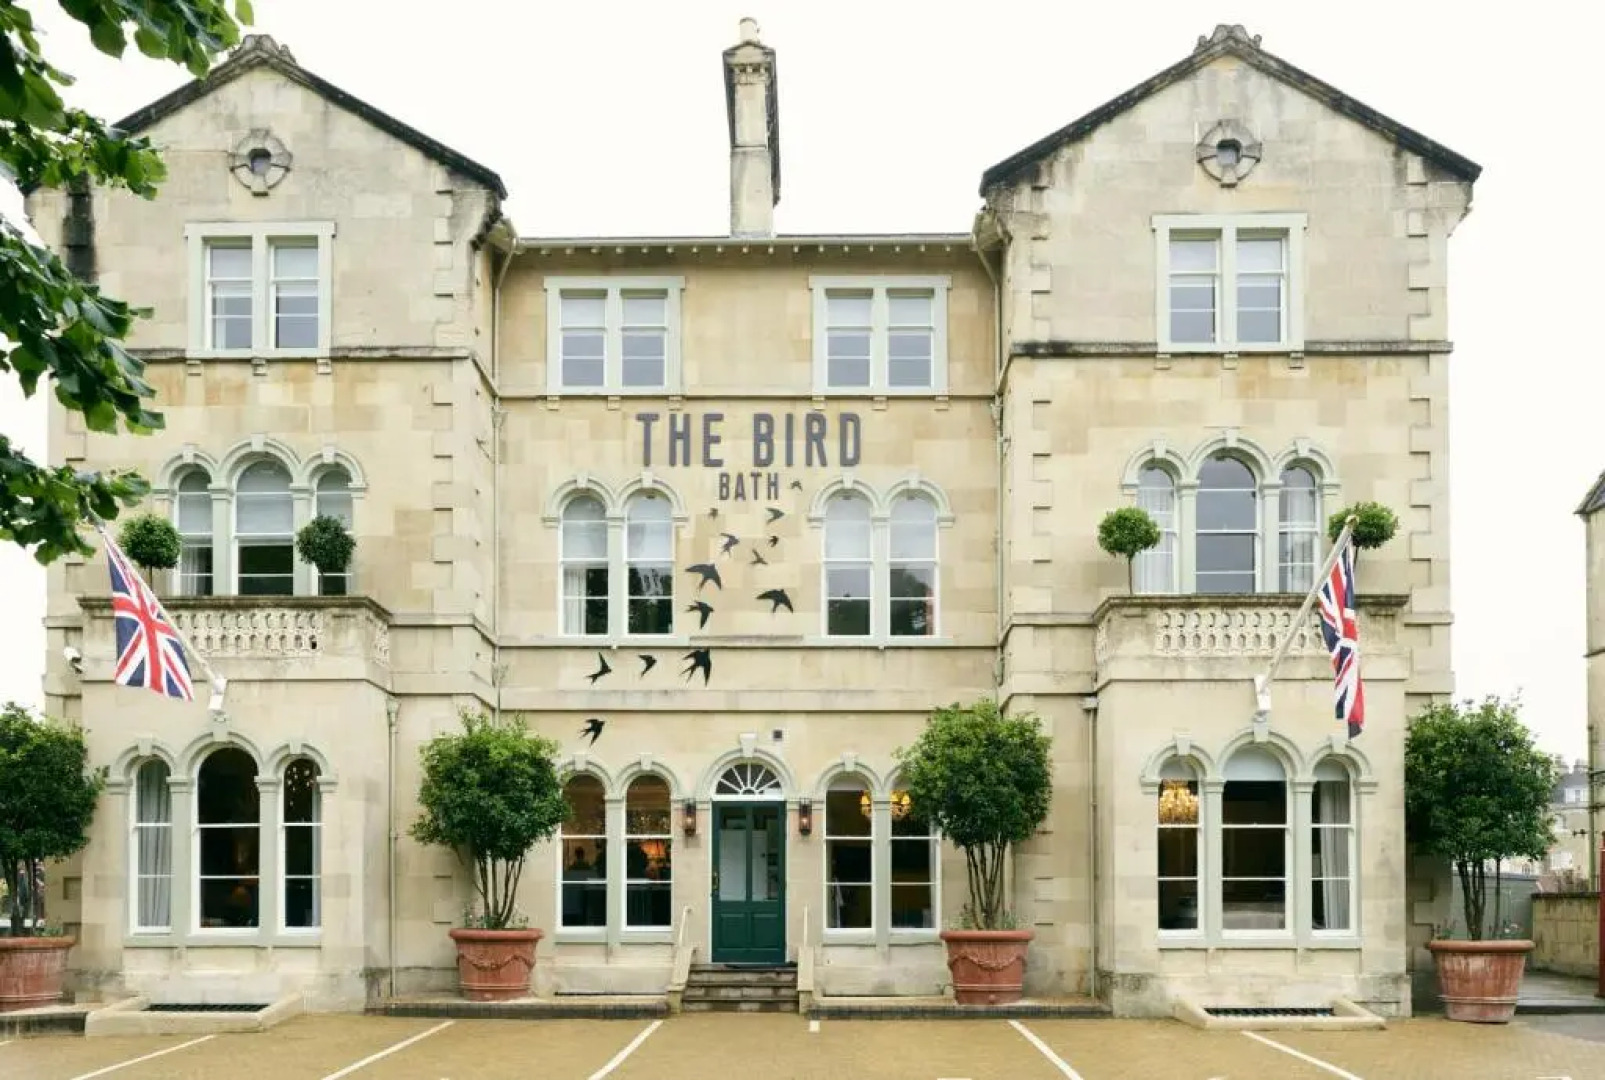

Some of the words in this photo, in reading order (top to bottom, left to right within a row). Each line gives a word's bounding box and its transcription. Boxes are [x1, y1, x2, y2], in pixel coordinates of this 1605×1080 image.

[635, 413, 724, 468] THE
[753, 413, 861, 468] BIRD
[719, 472, 779, 501] BATH
